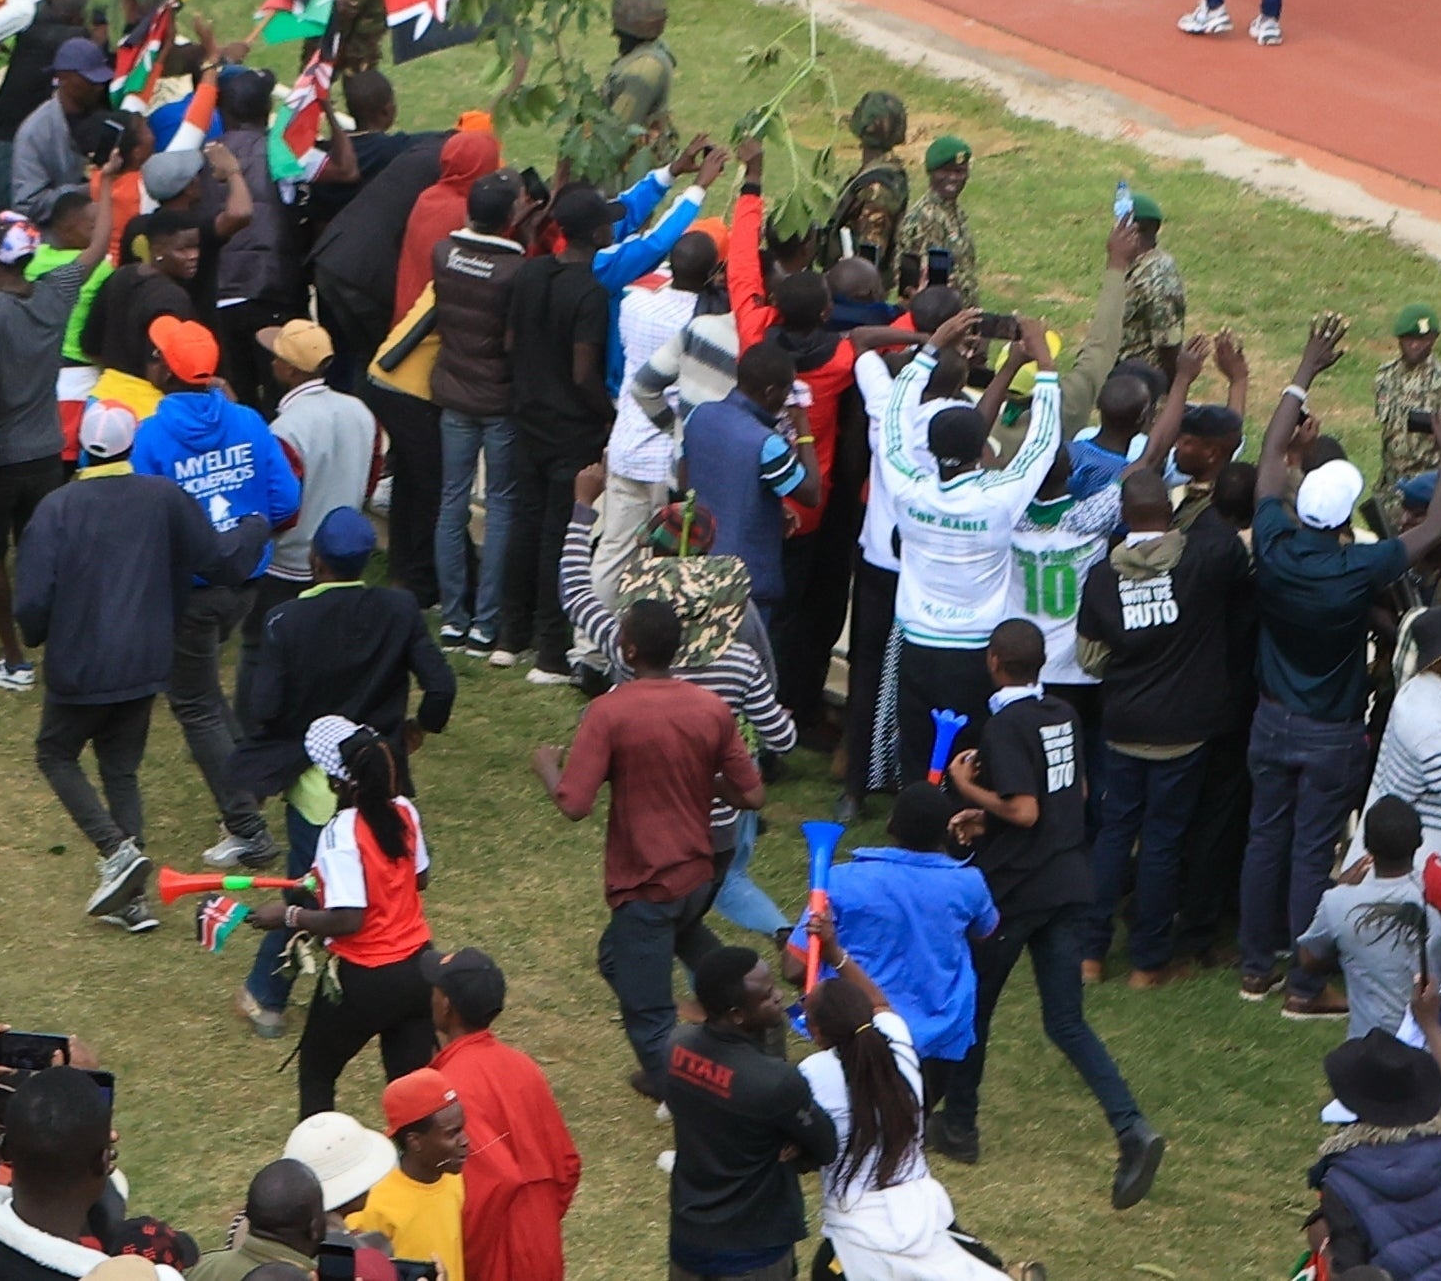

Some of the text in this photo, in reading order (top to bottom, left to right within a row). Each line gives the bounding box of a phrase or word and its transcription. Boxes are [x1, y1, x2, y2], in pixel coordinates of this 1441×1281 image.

[1020, 559, 1078, 618] 10
[1120, 585, 1174, 606] WITH US
[1122, 598, 1179, 631] RUTO
[671, 1045, 735, 1089] UTAH
